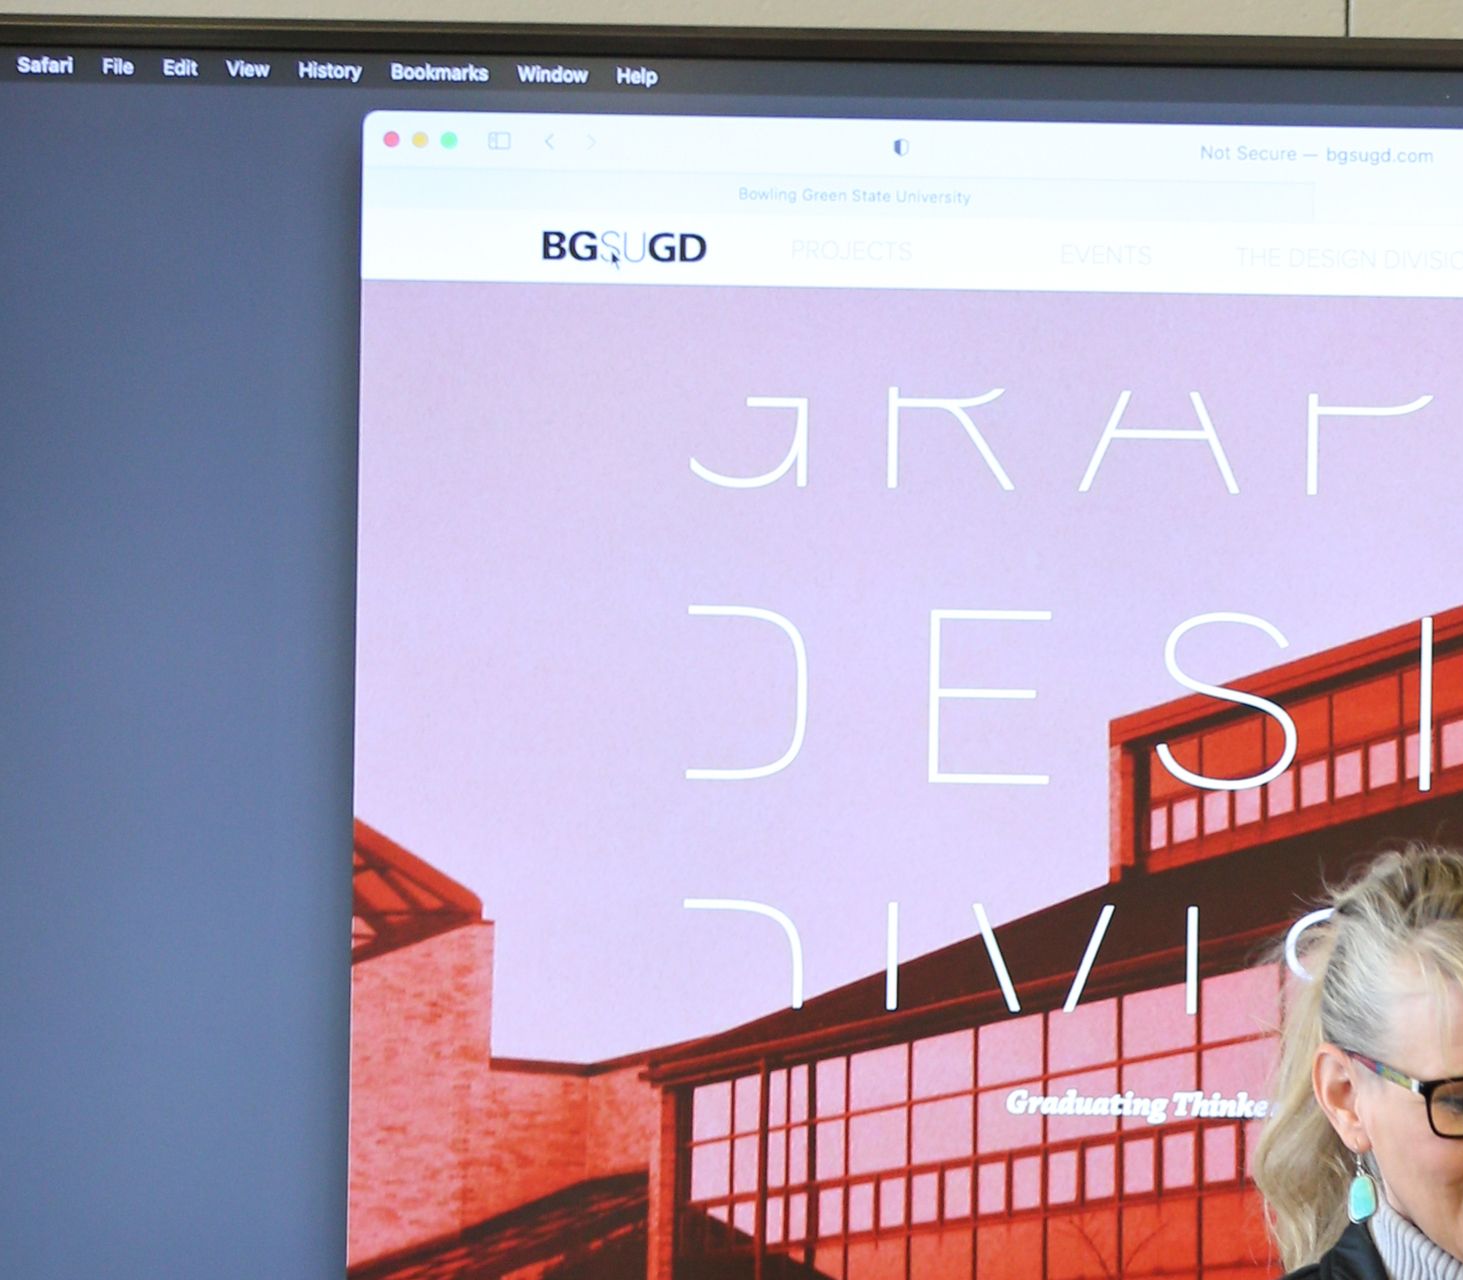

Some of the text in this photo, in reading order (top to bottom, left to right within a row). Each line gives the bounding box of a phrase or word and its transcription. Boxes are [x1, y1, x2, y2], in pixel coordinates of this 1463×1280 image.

[17, 55, 659, 88] Safari File Edit View History Bookmarks Window Help
[1200, 144, 1230, 161] Not
[1235, 144, 1297, 162] Secure
[1326, 146, 1434, 167] bgsugd.com
[738, 186, 972, 207] Bowling Green State University
[542, 230, 708, 264] BGSUGD
[791, 238, 913, 262] PROJECTS
[1060, 243, 1153, 266] EVENTS
[1235, 246, 1281, 267] THE
[1288, 247, 1377, 269] DESIGN
[1005, 1088, 1170, 1126] Graduating
